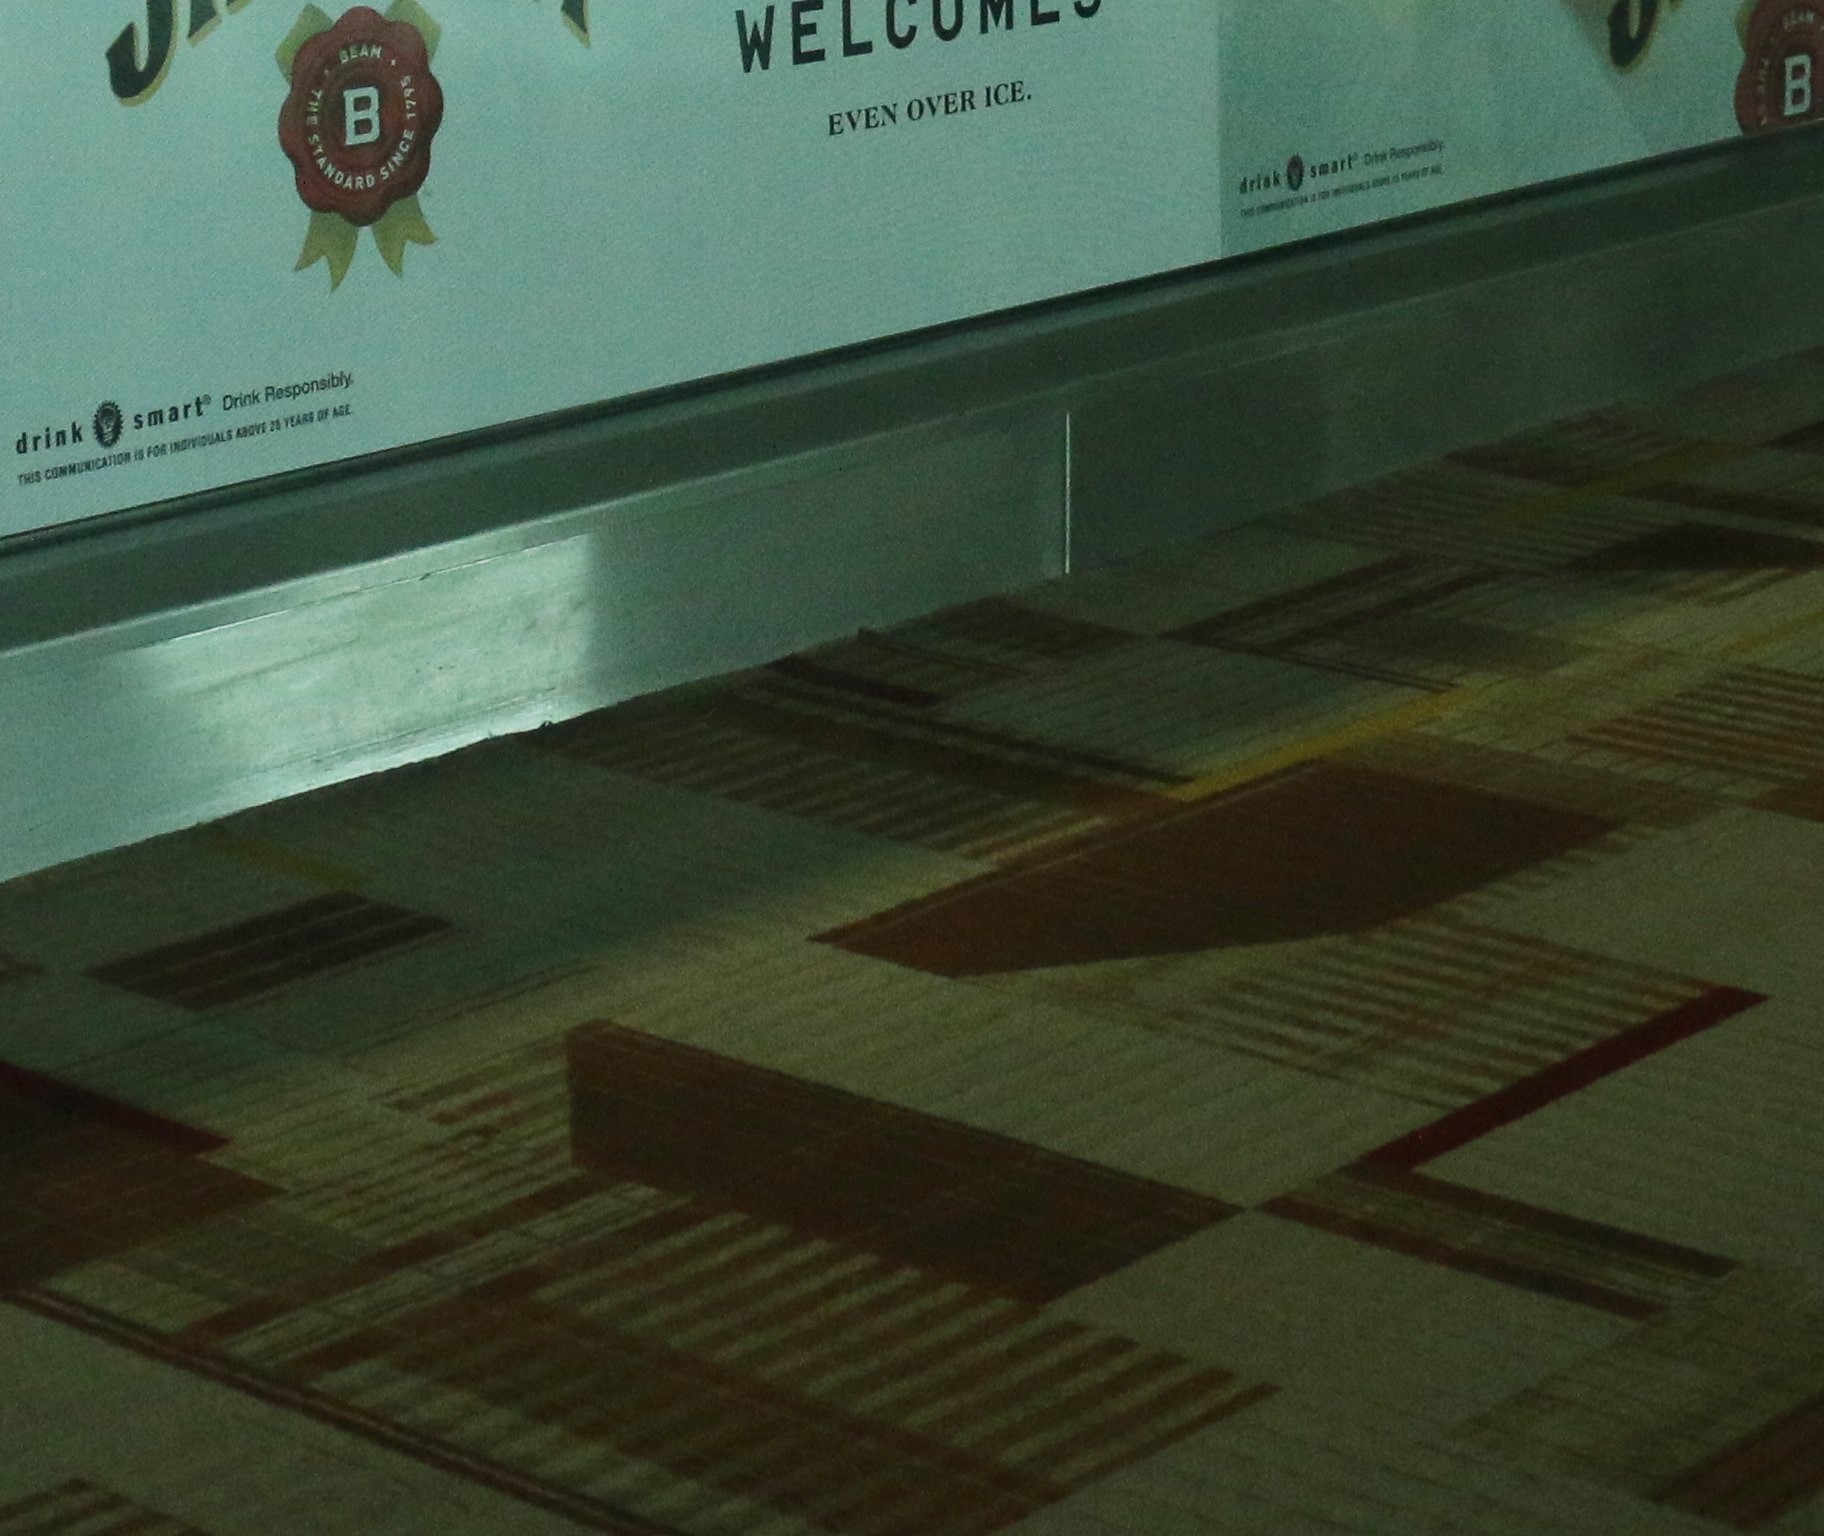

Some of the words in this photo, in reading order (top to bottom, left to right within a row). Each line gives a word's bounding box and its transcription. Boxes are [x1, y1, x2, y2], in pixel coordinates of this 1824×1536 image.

[338, 44, 384, 64] BEAM
[1783, 53, 1812, 117] B
[342, 85, 381, 147] B
[827, 101, 899, 138] EVEN
[906, 87, 977, 123] OVER
[984, 79, 1033, 109] ICE.
[308, 133, 376, 191] STANDARD
[379, 128, 415, 181] SINCE
[1239, 170, 1281, 195] drink
[15, 420, 84, 455] drink
[222, 389, 262, 412] Drink
[17, 470, 42, 487] THIS
[44, 451, 132, 481] COMMUNICATION
[134, 449, 145, 462] IS
[146, 443, 168, 459] FOR
[169, 428, 234, 455] INDIVIDUALS
[235, 420, 267, 440] ABOVE
[283, 410, 315, 430] YEARS
[317, 407, 330, 423] OF
